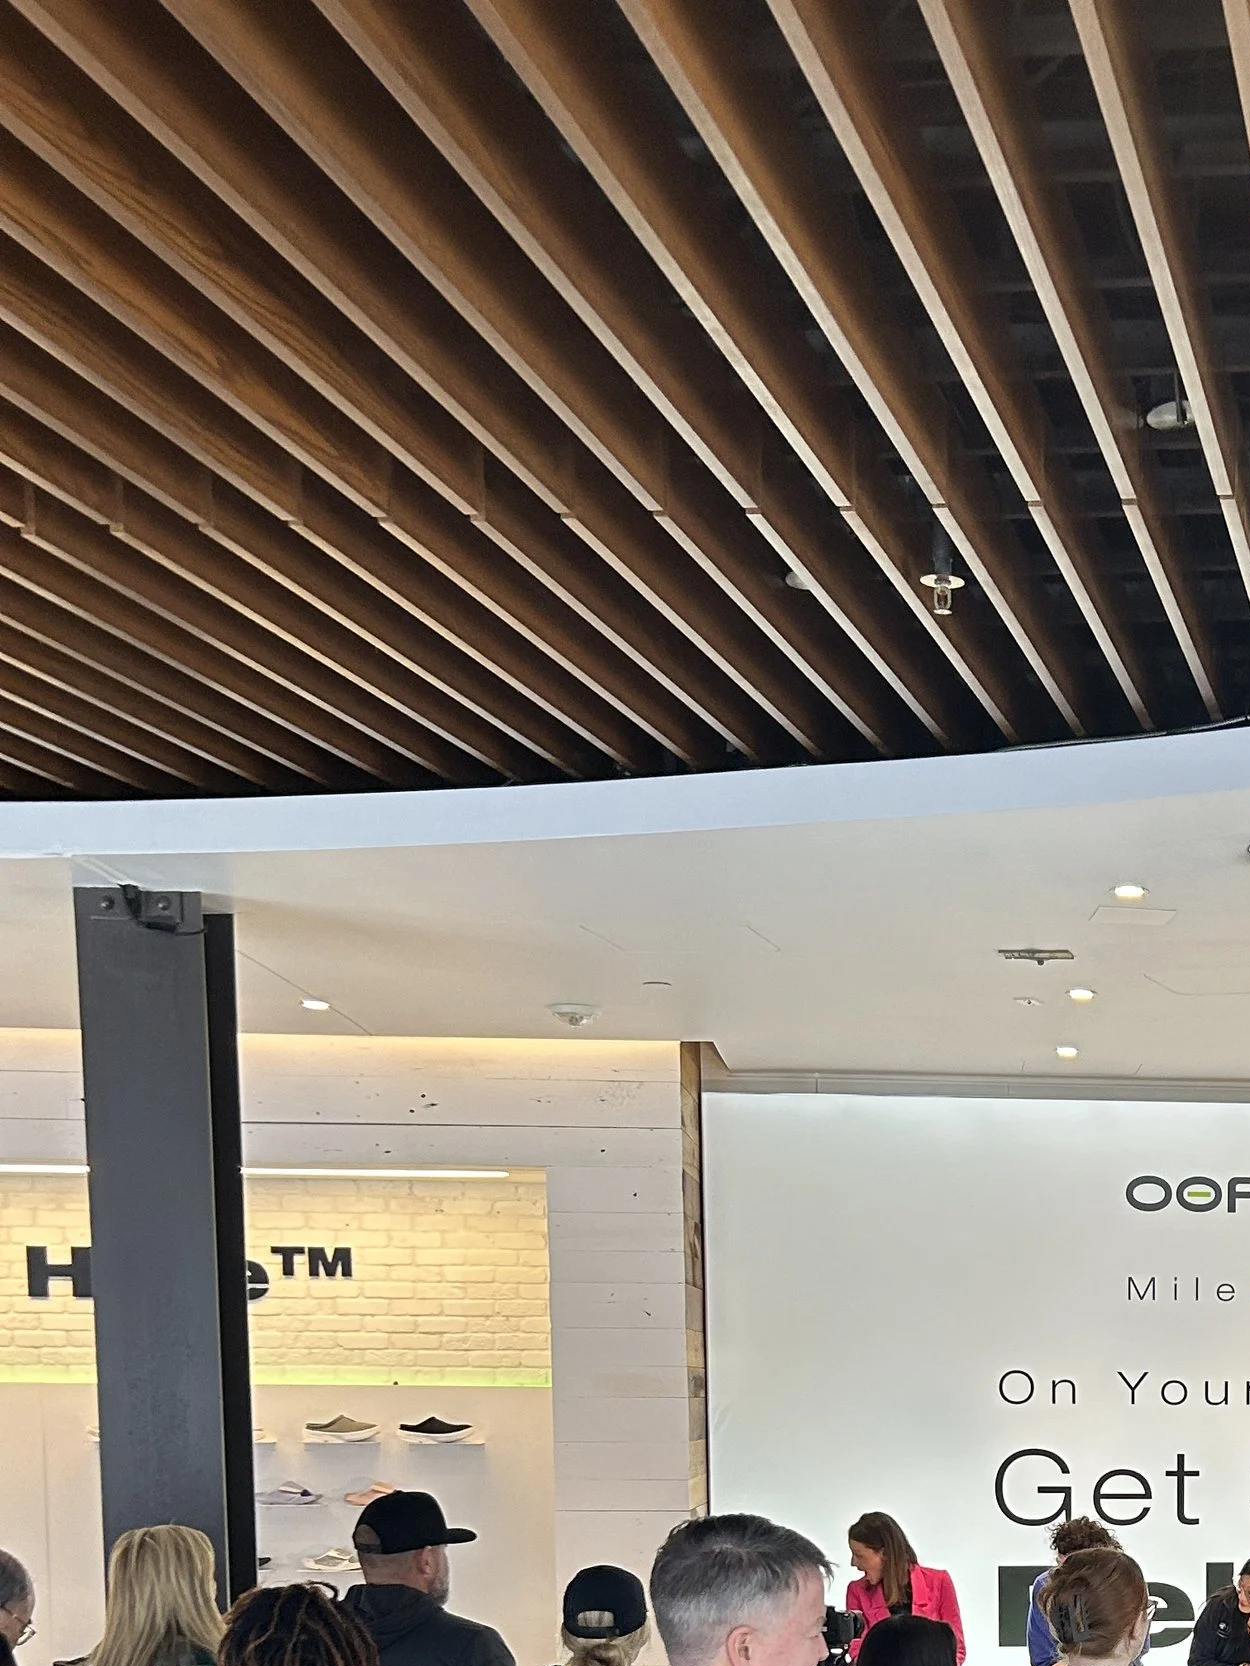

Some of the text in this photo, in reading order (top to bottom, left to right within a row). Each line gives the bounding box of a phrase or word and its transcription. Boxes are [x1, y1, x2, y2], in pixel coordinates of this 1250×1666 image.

[1128, 1276, 1235, 1302] Mile
[998, 1369, 1076, 1405] On
[994, 1448, 1200, 1527] Get
